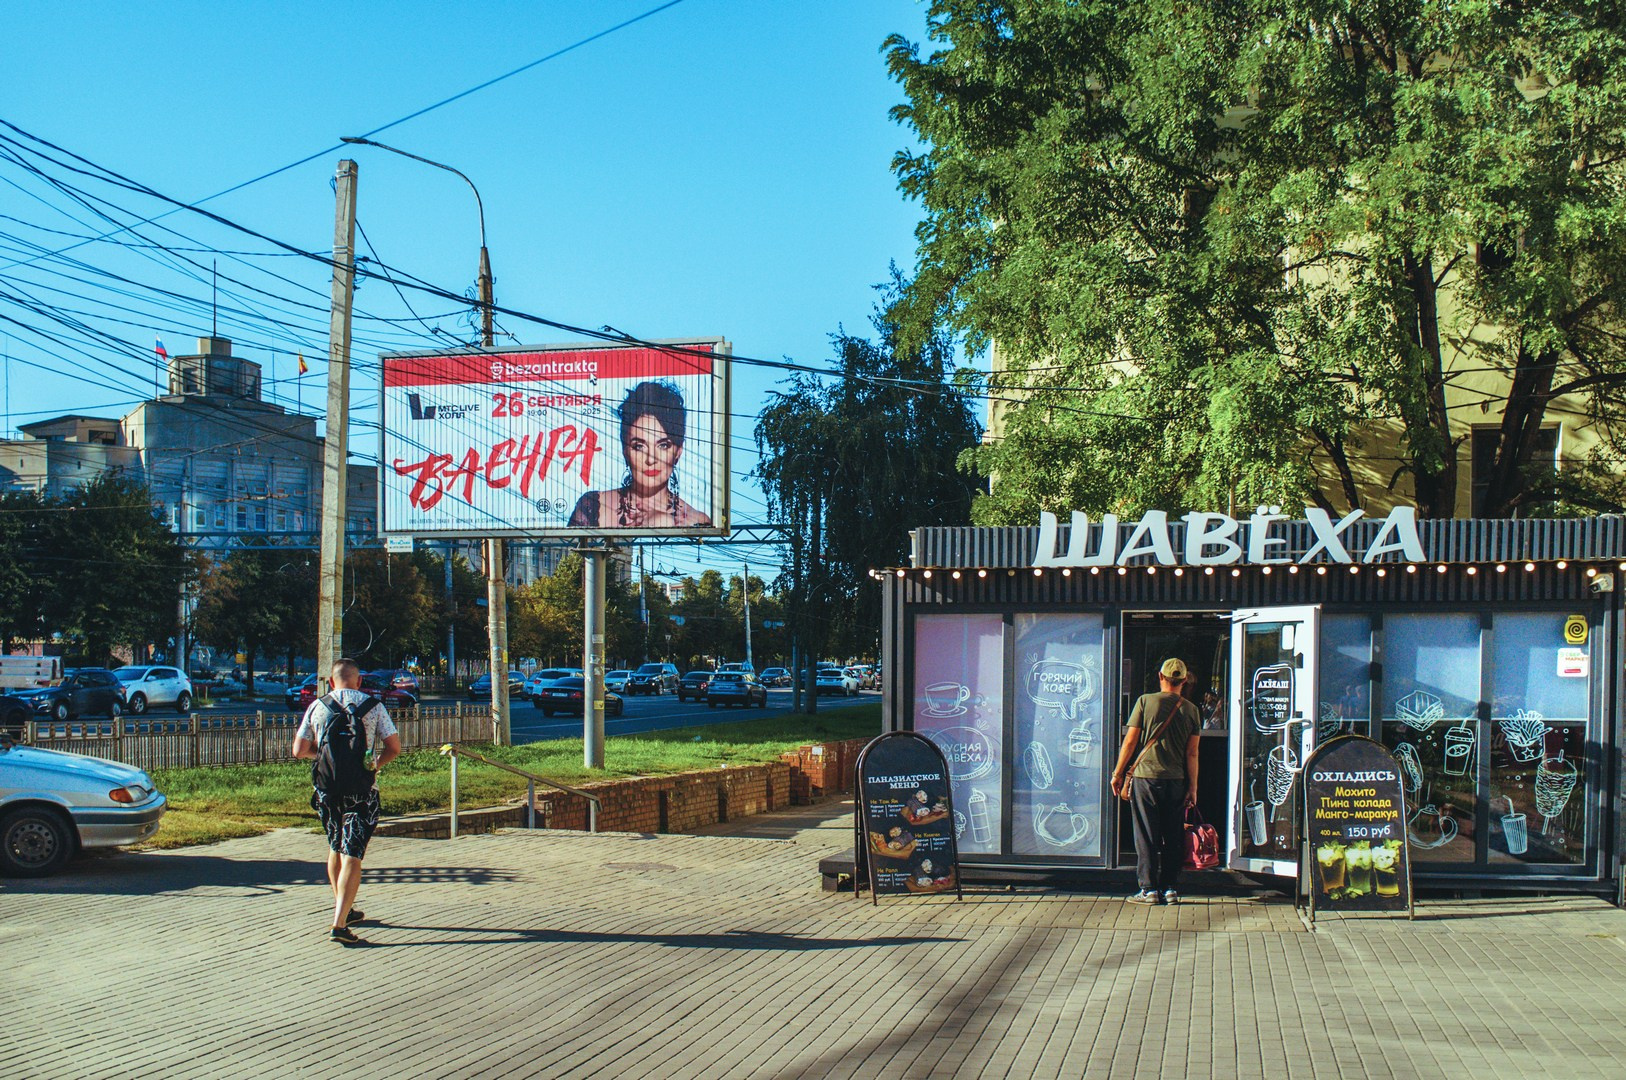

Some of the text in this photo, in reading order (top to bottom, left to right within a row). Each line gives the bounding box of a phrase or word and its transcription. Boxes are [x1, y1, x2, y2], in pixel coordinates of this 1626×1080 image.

[506, 360, 598, 375] bezantrakta
[491, 392, 601, 418] 26 СЕНТЯБРЯ
[393, 424, 602, 512] ВАЕНГА
[1031, 504, 1426, 567] ШАВЁХА
[1033, 671, 1082, 683] ГОРЯЧИЙ
[1043, 683, 1072, 694] КОФЕ
[868, 774, 941, 784] ПАНАЗИАТСКОЕ
[1312, 771, 1396, 783] ОХЛАДИСЬ
[1335, 786, 1376, 797] Мохито
[1320, 797, 1392, 808] Пина колада
[1315, 808, 1398, 822] Манго-маракуя
[1348, 827, 1368, 837] 150
[1371, 824, 1391, 838] руб
